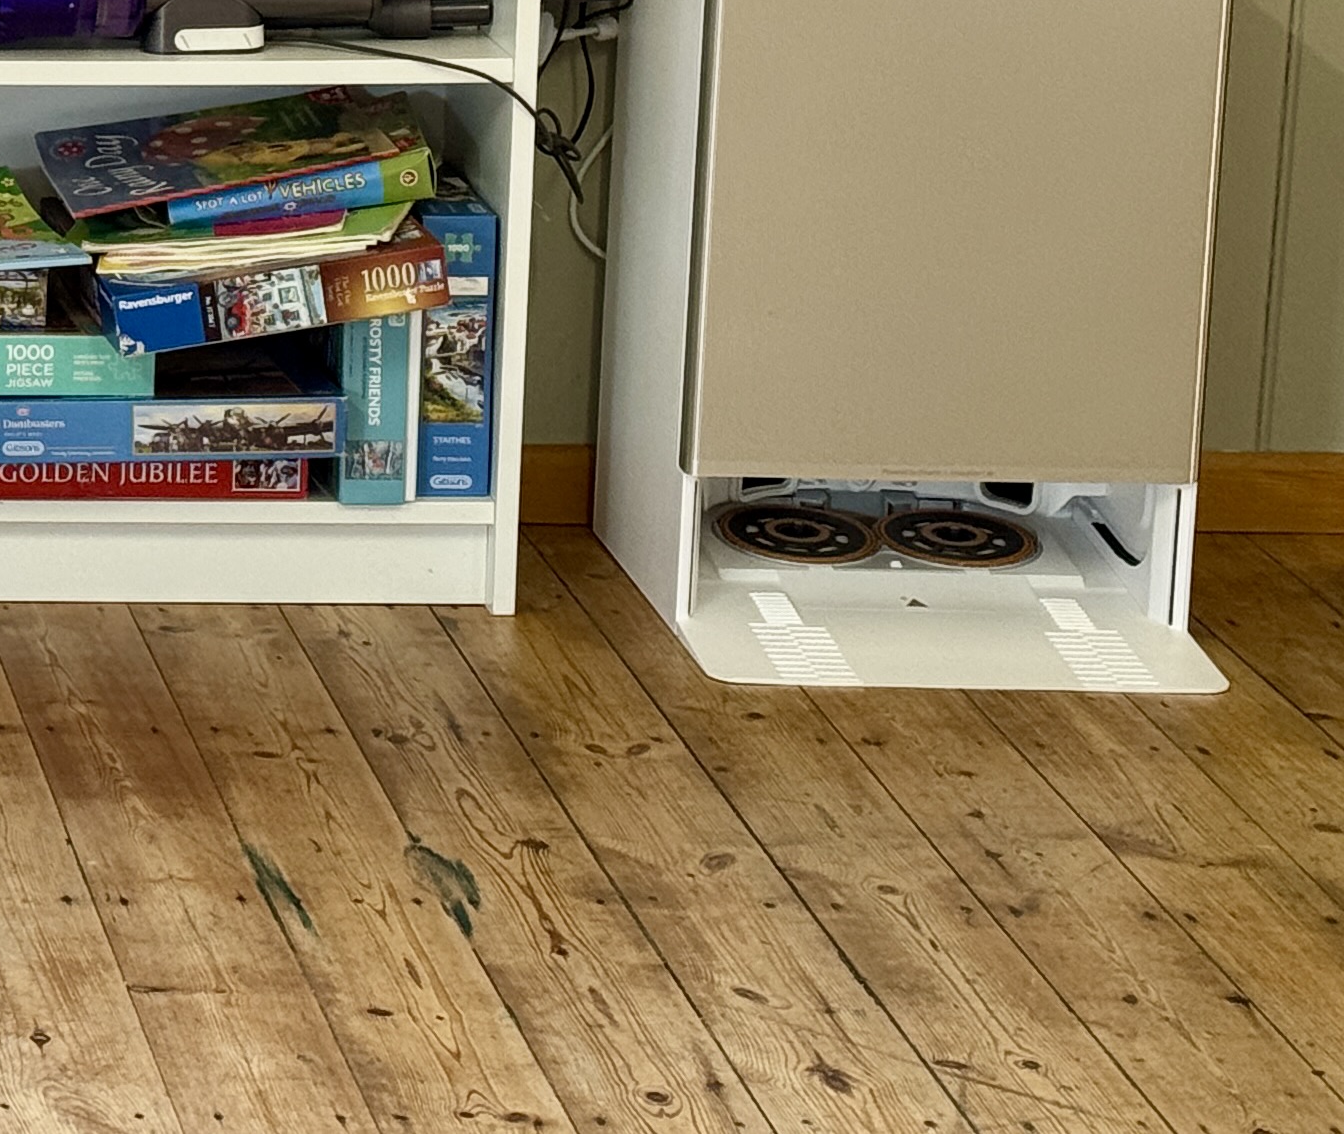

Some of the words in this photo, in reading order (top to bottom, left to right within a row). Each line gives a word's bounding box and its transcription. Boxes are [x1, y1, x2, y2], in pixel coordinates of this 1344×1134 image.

[279, 172, 367, 200] VEHICLES
[361, 262, 416, 292] 1000
[118, 291, 193, 312] Ravensburger
[5, 344, 54, 359] 1000
[5, 362, 54, 376] PIECE
[5, 377, 53, 388] JIGSAW
[368, 367, 381, 427] FRIENDS
[120, 462, 218, 485] JUBILEE
